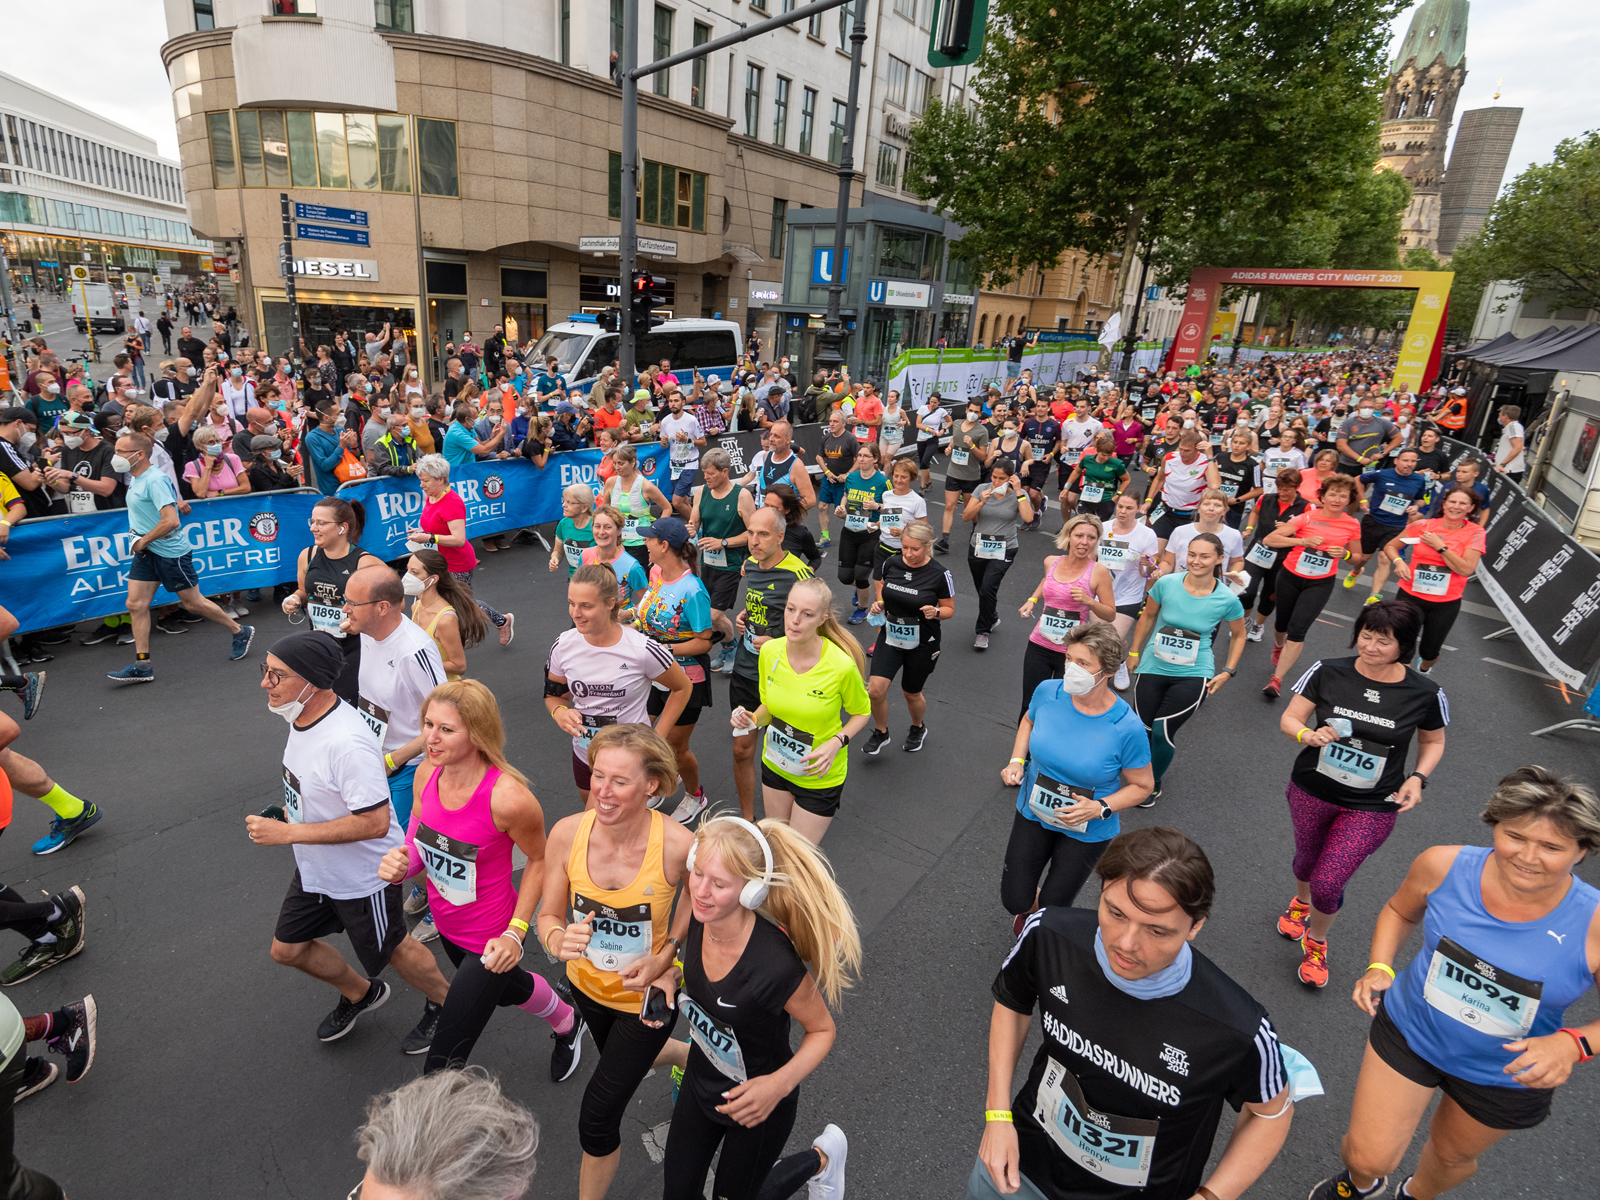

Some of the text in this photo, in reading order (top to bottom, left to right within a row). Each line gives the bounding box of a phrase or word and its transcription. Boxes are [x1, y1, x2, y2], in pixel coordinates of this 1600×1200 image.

[638, 240, 675, 252] Kurfürstendamm
[1231, 271, 1403, 283] ADIDAS RUNNERS CITY NIGHT 2021
[871, 282, 883, 302] U
[793, 318, 800, 327] U
[720, 439, 739, 450] CITY
[734, 464, 749, 475] LIN
[71, 493, 91, 501] 7959
[61, 517, 250, 571] ERDGER
[982, 541, 1003, 549] 11775
[1100, 548, 1123, 558] 11926
[1255, 545, 1273, 559] 11417
[1303, 555, 1330, 568] 11231
[71, 547, 280, 596] ALKOLFREI
[1418, 572, 1446, 582] 11867
[317, 584, 339, 597] CITY
[312, 605, 342, 620] 11898
[889, 624, 915, 636] 11431
[1045, 616, 1075, 629] 11234
[1161, 635, 1193, 650] 11235
[1333, 705, 1396, 729] #ADIDASRUNNERS
[772, 730, 806, 757] 11942
[1329, 744, 1375, 771] 11716
[422, 846, 467, 881] 11712
[588, 918, 641, 938] 1408
[600, 940, 623, 951] Sabine
[1445, 960, 1520, 1012] 11094
[1461, 992, 1491, 1012] Karina
[688, 1004, 733, 1053] 11407
[1043, 1010, 1182, 1106] #ADIDASRUNNERS
[1159, 1051, 1190, 1069] NIGHT
[1165, 1047, 1188, 1062] CITY
[1166, 1062, 1189, 1077] 2021
[1063, 1103, 1140, 1158] 11321
[1079, 1140, 1111, 1163] Henryk
